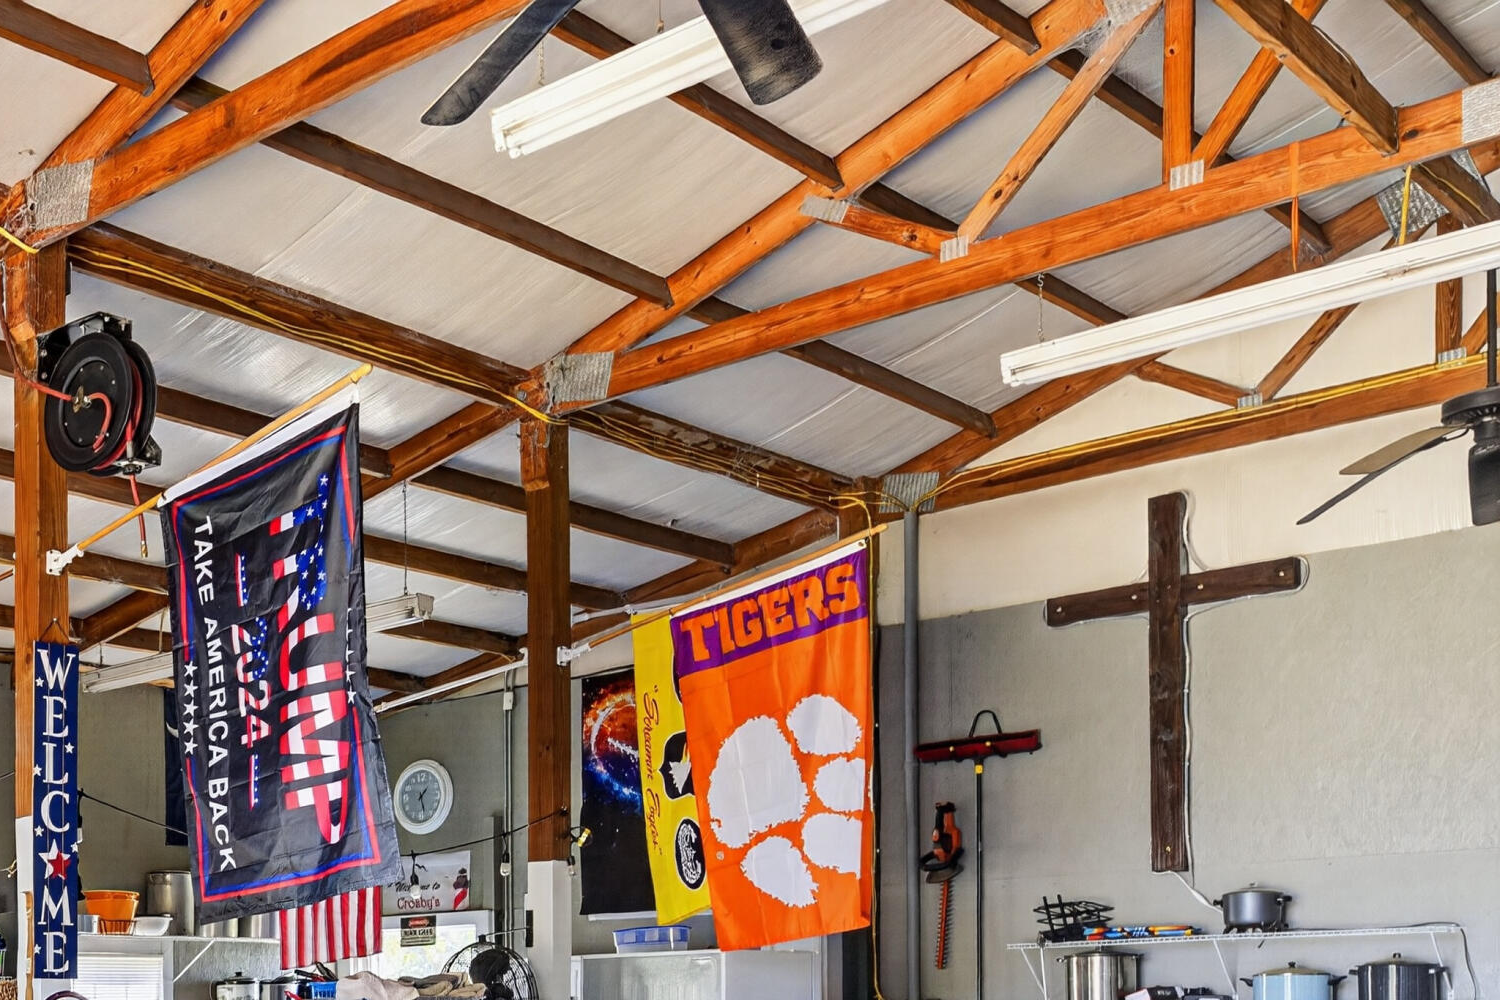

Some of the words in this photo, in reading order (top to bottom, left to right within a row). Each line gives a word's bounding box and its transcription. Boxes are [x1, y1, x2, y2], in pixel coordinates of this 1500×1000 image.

[194, 515, 214, 606] TAKE
[269, 472, 350, 845] TRUMP
[680, 562, 861, 662] TIGERS
[204, 617, 228, 768] AMERICA
[231, 617, 272, 749] 2024
[208, 777, 237, 871] BACK
[397, 896, 441, 911] Crosby's
